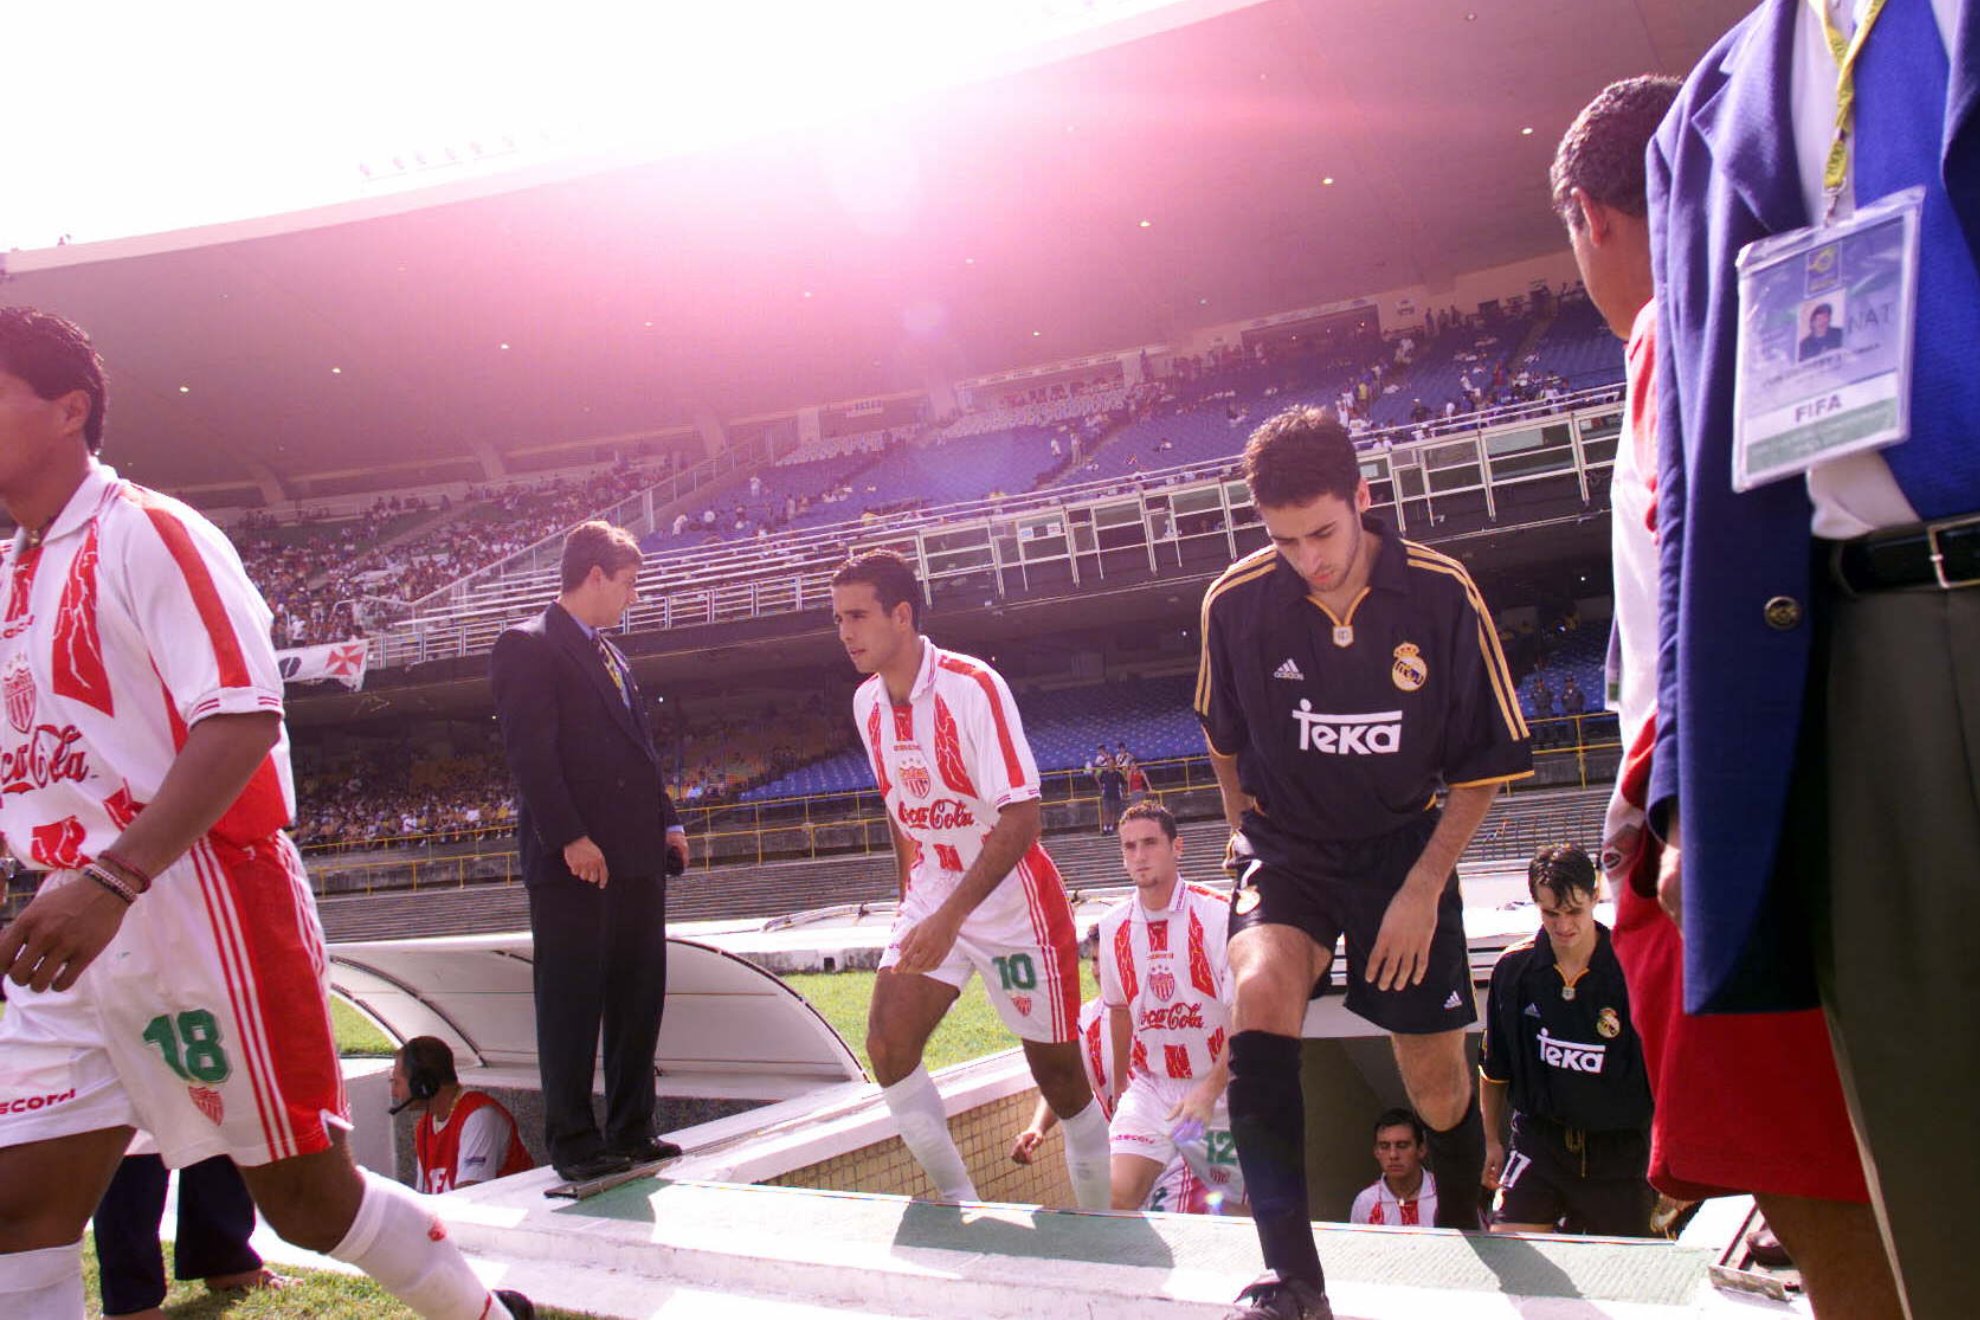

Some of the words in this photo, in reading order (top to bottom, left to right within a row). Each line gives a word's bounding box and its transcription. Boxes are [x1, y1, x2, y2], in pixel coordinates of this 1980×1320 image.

[1795, 394, 1842, 422] FIFA
[992, 953, 1036, 990] 10
[142, 1009, 232, 1083] 18
[1204, 1130, 1238, 1166] 12
